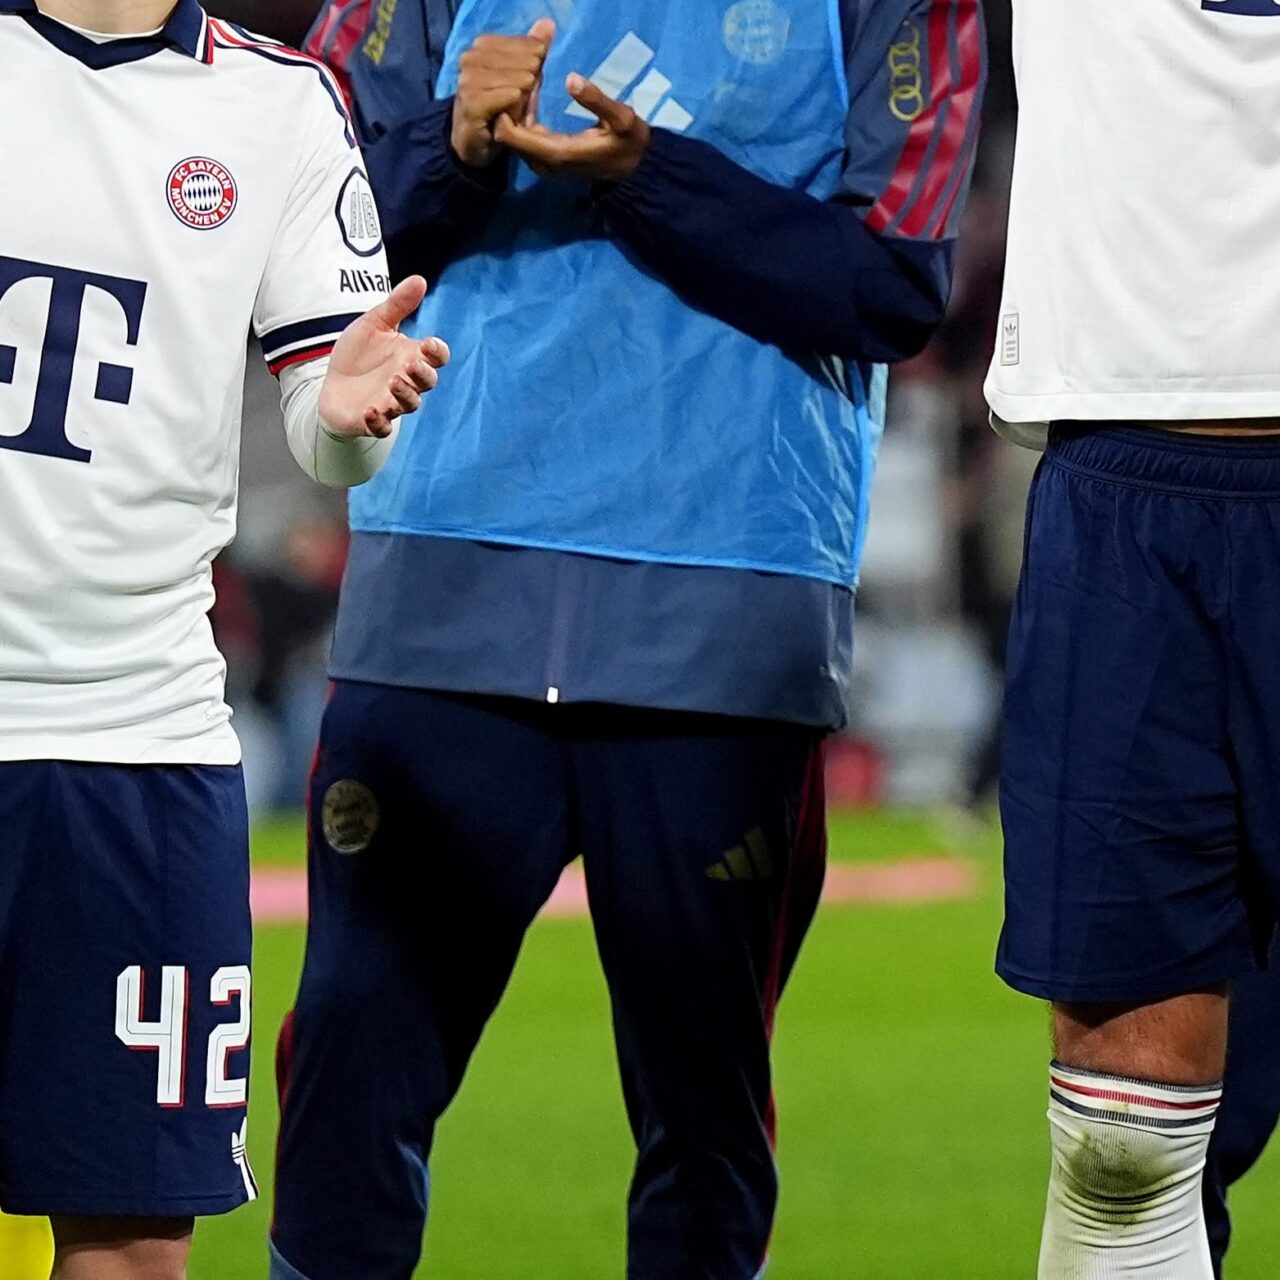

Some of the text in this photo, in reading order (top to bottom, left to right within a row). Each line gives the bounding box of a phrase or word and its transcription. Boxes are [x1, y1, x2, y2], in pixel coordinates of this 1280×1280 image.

[175, 161, 231, 189] FC BAYERN
[115, 965, 251, 1108] 42
